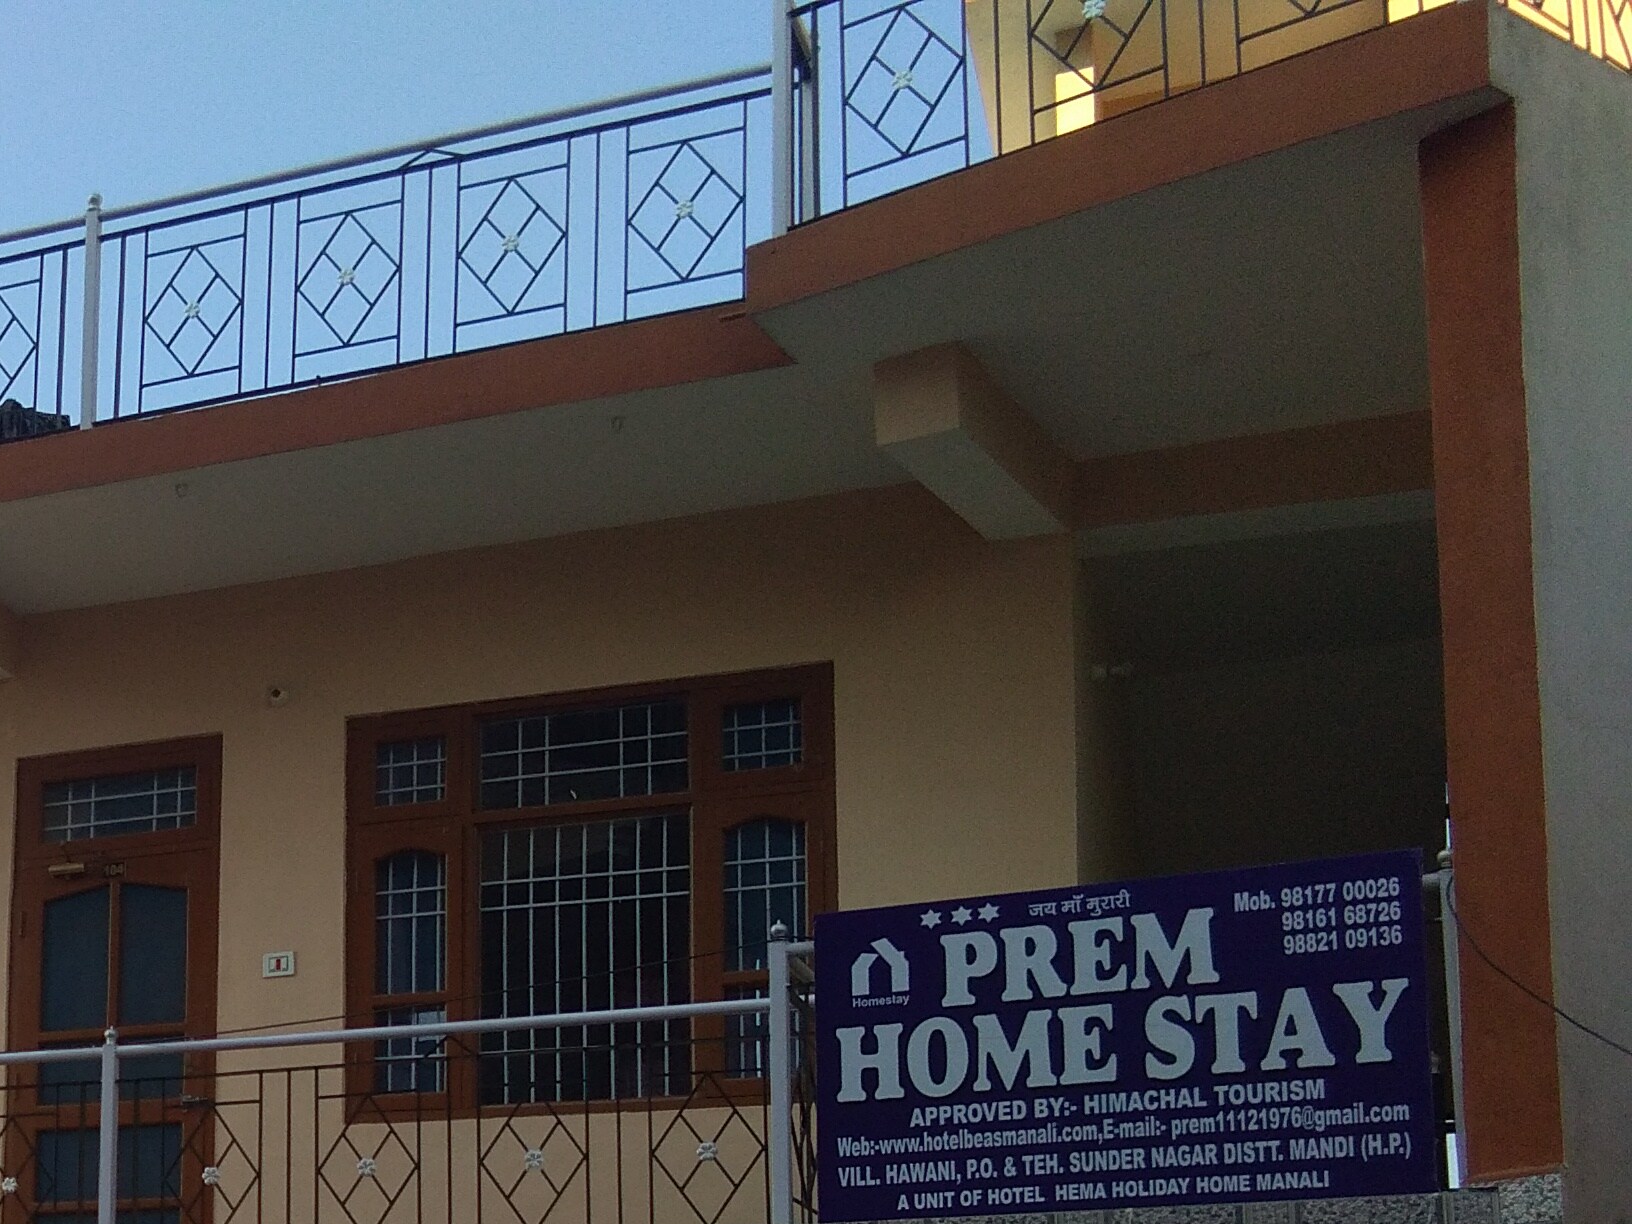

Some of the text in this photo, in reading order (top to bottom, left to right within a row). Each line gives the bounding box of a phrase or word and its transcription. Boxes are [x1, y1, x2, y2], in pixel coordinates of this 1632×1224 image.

[1028, 902, 1057, 916] जय
[1086, 889, 1131, 916] मुरारी
[1234, 877, 1400, 912] Mob. 98177 00026
[1282, 901, 1401, 931] 98161 68726
[940, 907, 1220, 1008] PREM
[1283, 925, 1402, 955] 98821 09136
[852, 994, 910, 1008] Homestay
[836, 977, 1410, 1103] HOME STAY
[910, 1079, 1325, 1128] APPROVED BY:- HIMACHAL TOURISM
[1171, 1102, 1410, 1140] prem11121976@gmail.com
[838, 1132, 1411, 1187] VILL. HAWANI, P.O. & TEH. SUNDER NAGAR DISTT. MANDI (H.P.)
[897, 1170, 1329, 1210] A UNIT OF HOTEL HEMA HOLIDAY HOME MANALI
